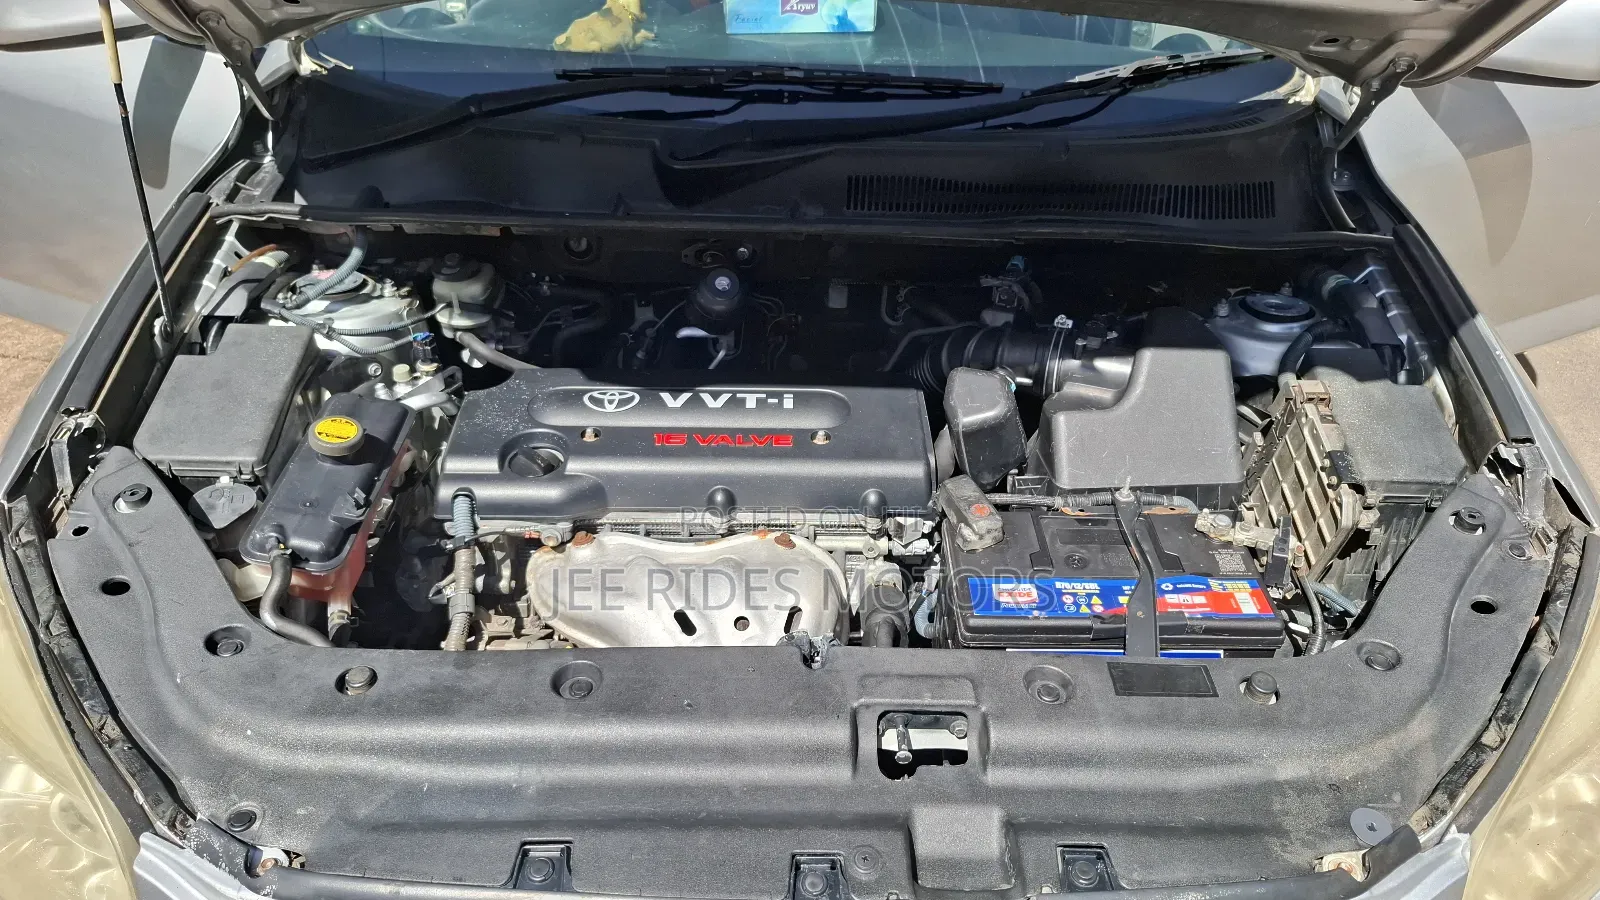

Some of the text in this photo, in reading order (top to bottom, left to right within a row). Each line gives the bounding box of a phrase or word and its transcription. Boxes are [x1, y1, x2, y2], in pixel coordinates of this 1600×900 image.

[659, 392, 794, 409] VVT-i
[654, 433, 793, 447] 16 VALVE
